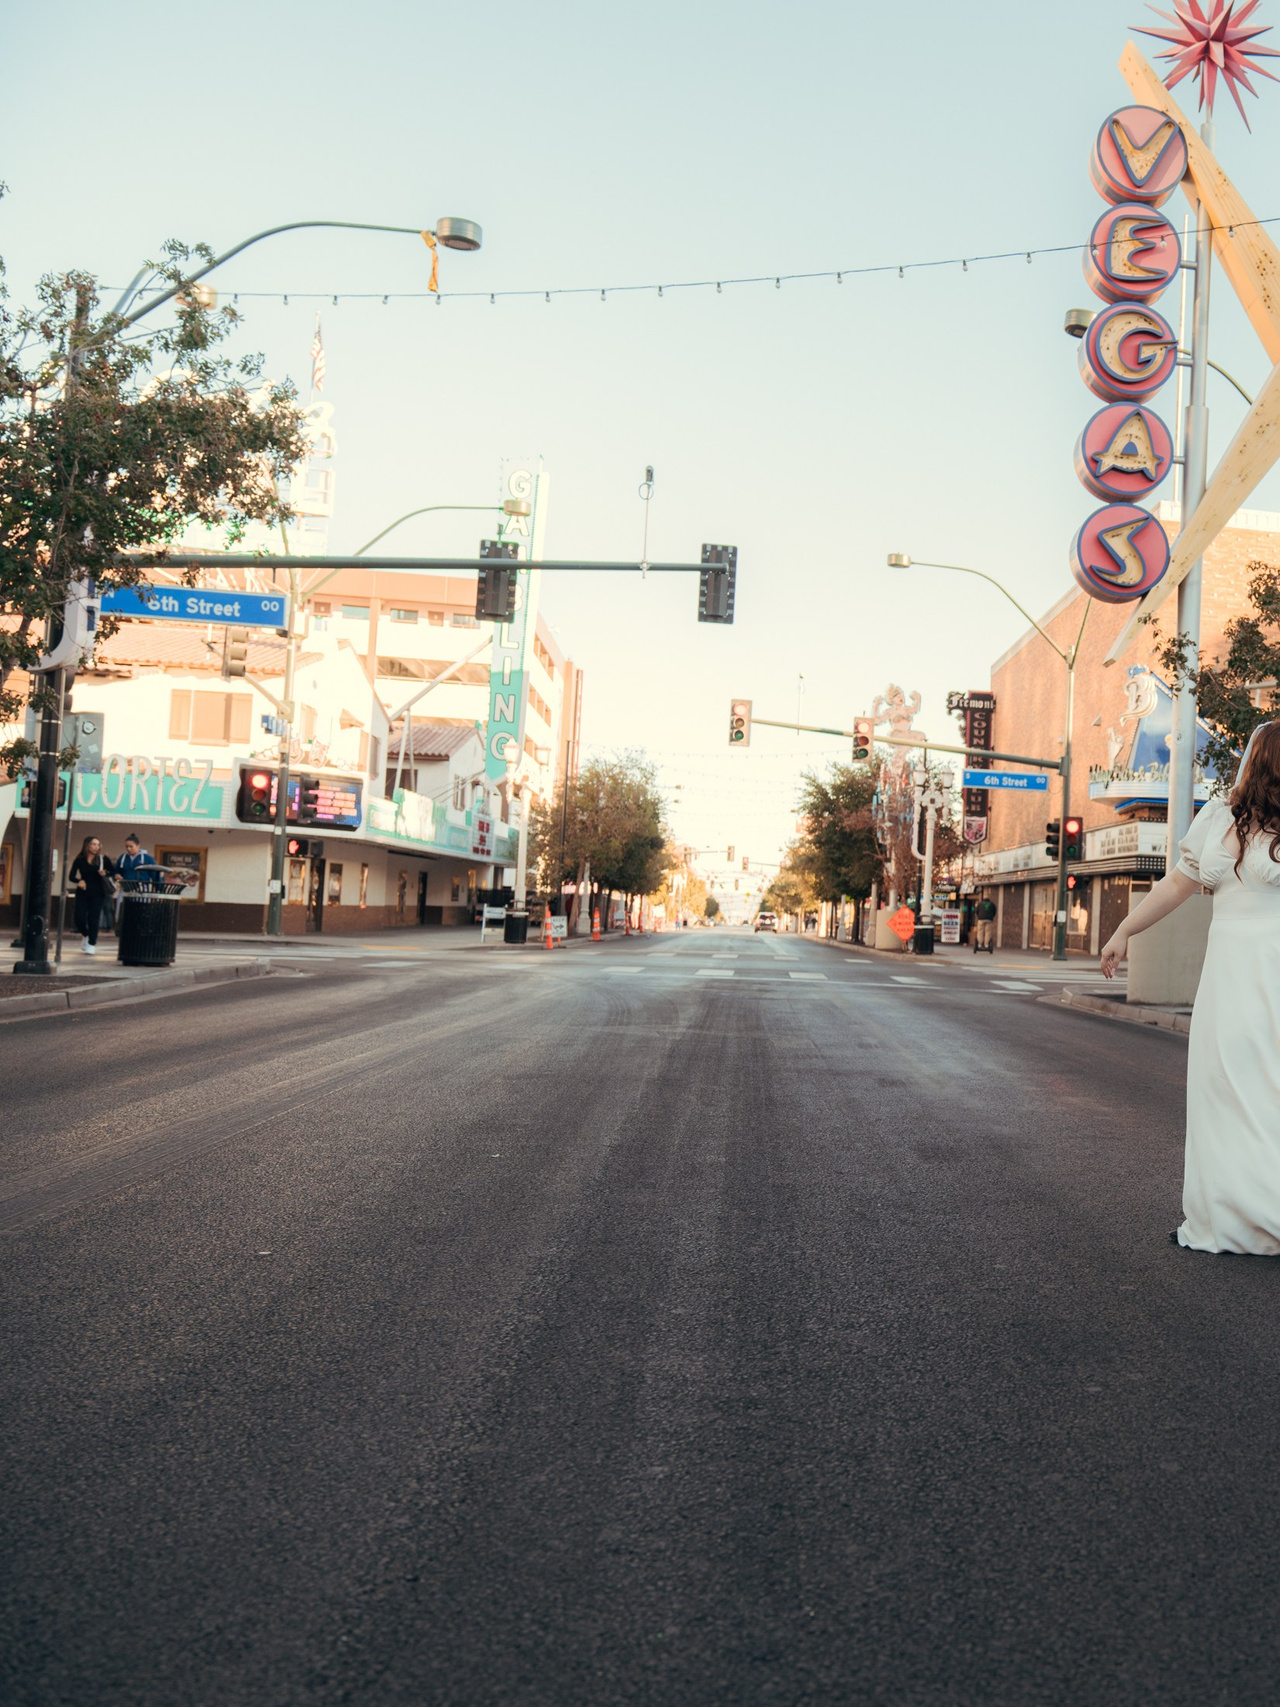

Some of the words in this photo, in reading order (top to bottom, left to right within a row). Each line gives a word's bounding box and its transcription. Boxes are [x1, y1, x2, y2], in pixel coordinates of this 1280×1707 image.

[1091, 117, 1180, 588] VEGAS
[147, 594, 179, 613] 6th
[186, 597, 241, 618] Street
[490, 470, 532, 761] GALING
[972, 711, 987, 769] COUNRY
[77, 754, 214, 814] CORTEZ
[984, 775, 1000, 786] 6th
[1001, 776, 1028, 788] Street
